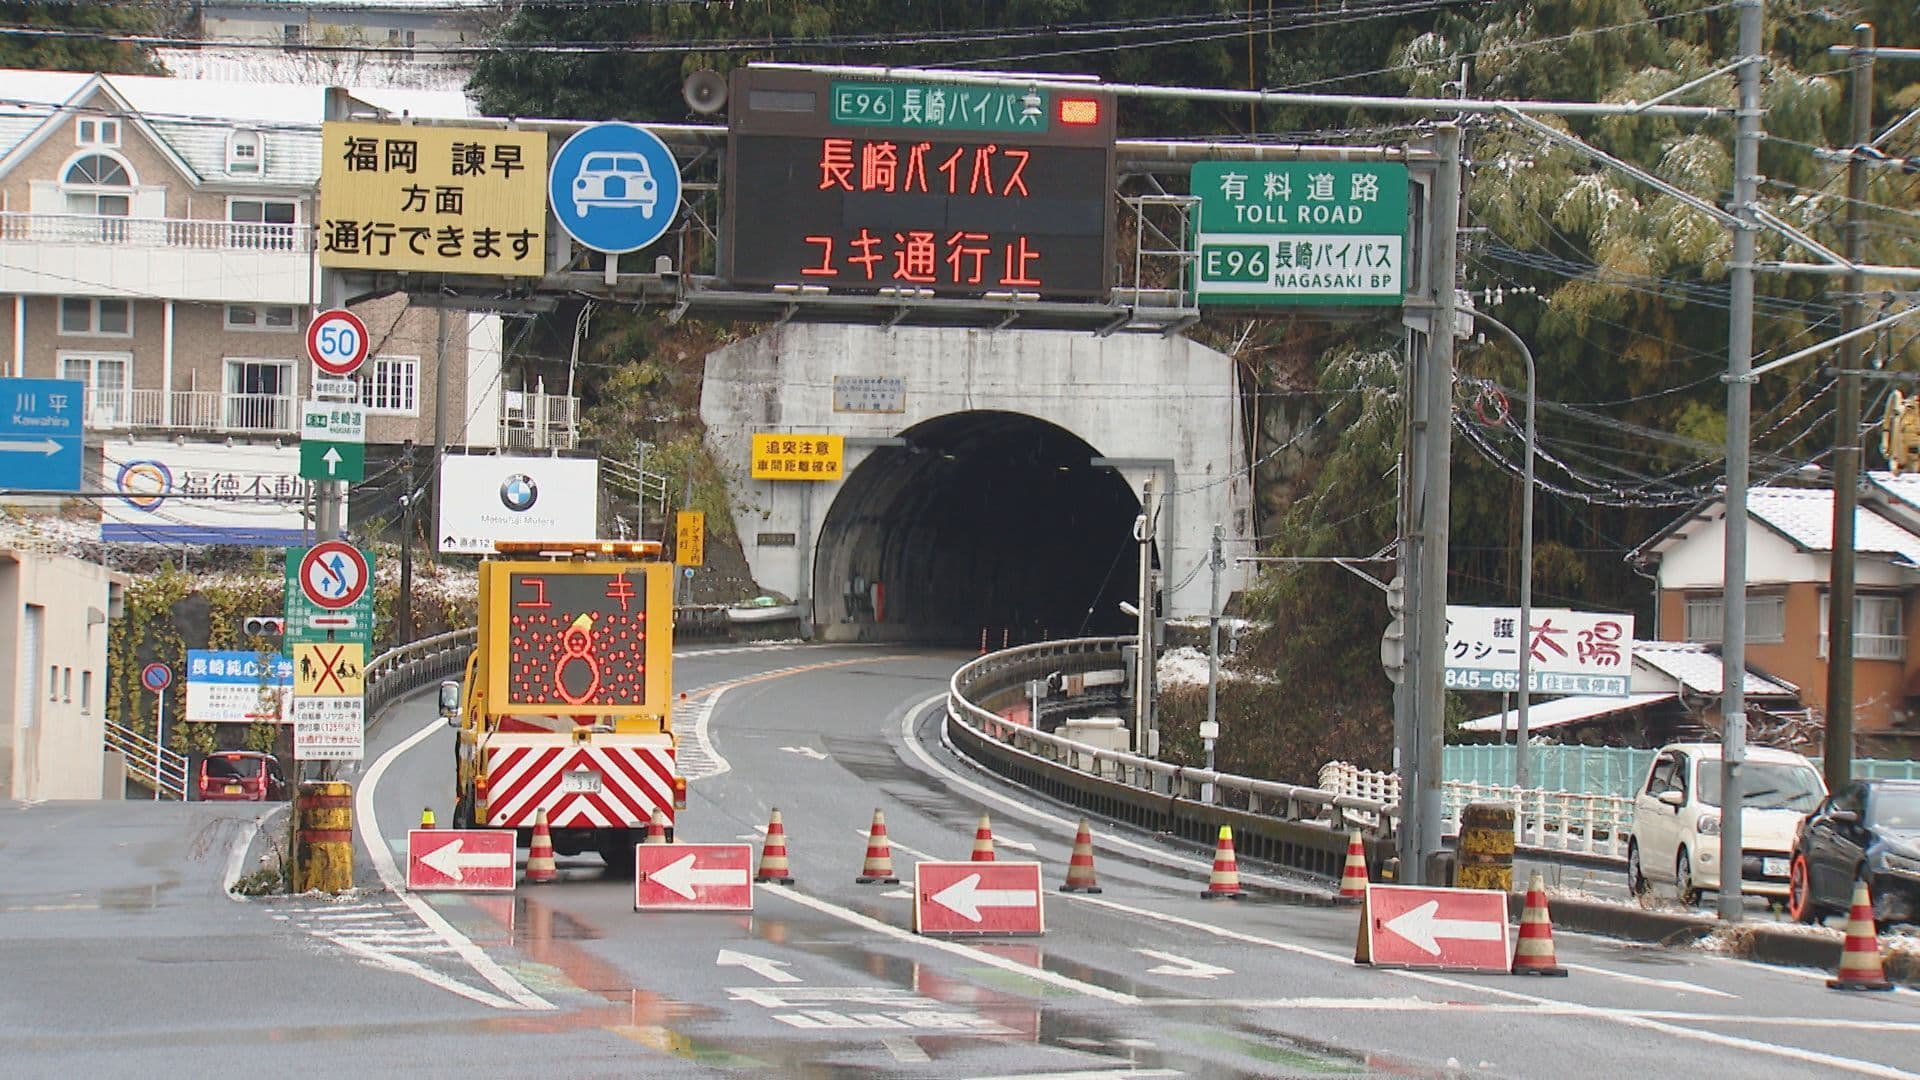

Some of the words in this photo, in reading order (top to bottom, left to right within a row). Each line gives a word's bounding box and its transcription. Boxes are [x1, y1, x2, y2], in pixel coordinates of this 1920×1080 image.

[840, 95, 887, 114] E96
[343, 136, 418, 174] 福岡
[451, 141, 525, 179] 諫早
[818, 138, 1031, 197] 長崎バイパス
[401, 183, 464, 216] 方面
[1220, 171, 1380, 202] 有料道路
[1235, 205, 1288, 224] TOLL
[1298, 206, 1363, 224] ROAD
[324, 219, 539, 261] 通行できます
[801, 229, 1042, 287] ユキ通行止
[1207, 250, 1265, 276] E96
[1275, 241, 1391, 269] 長崎バイパス
[1274, 274, 1362, 288] NAGASAKI
[1370, 275, 1392, 288] BP
[321, 327, 355, 356] 50
[16, 392, 69, 414] 川平
[12, 415, 70, 427] Kawahira
[766, 441, 830, 455] 追突注意
[757, 459, 838, 473] 車間距離確保
[1529, 618, 1623, 666] 太陽
